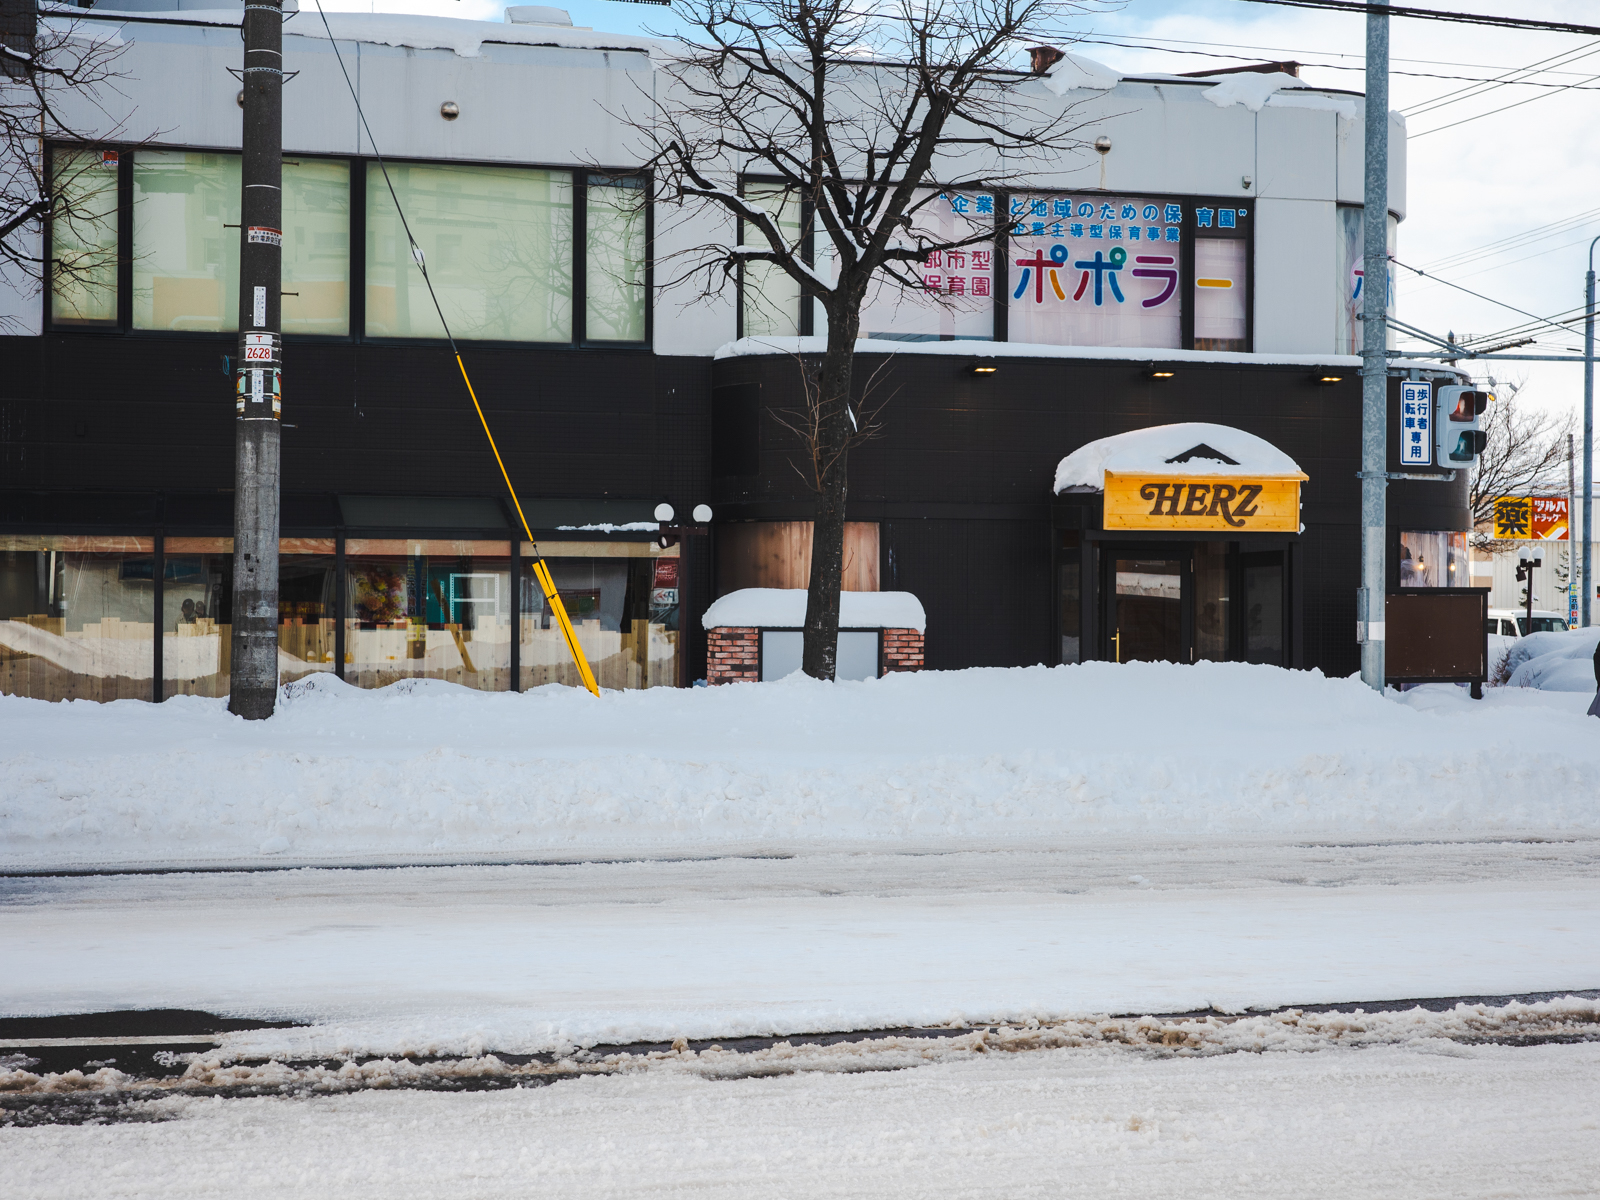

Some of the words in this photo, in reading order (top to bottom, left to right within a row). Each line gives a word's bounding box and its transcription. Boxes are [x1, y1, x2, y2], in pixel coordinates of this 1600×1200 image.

[924, 250, 990, 270] 都市型
[923, 274, 990, 296] 保育園
[1014, 244, 1233, 308] ポポラー
[255, 335, 263, 343] T
[247, 347, 270, 359] 2628
[1405, 388, 1416, 429] 自転車
[1417, 388, 1428, 430] 歩行者
[1411, 431, 1422, 458] 専用
[1140, 483, 1263, 527] HERZ
[1534, 500, 1566, 512] ツルハ
[1498, 501, 1528, 534] 薬
[1534, 513, 1561, 522] ドラッグ
